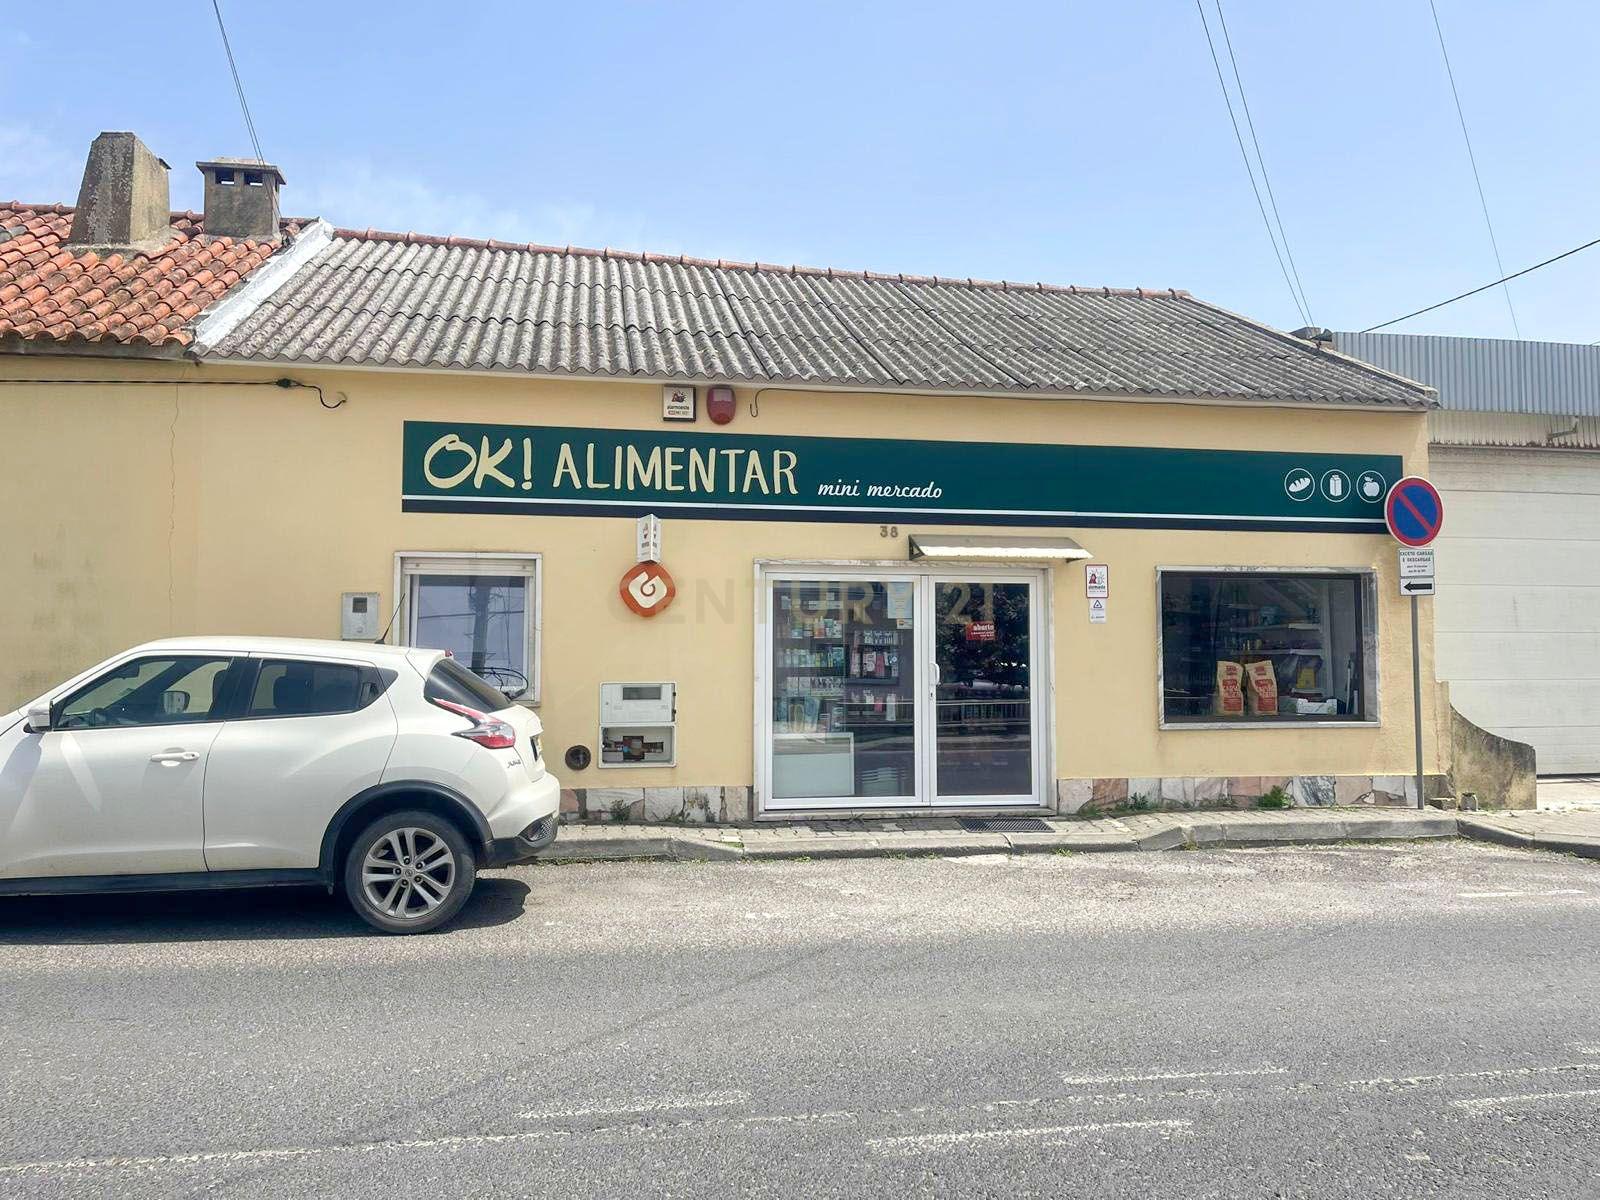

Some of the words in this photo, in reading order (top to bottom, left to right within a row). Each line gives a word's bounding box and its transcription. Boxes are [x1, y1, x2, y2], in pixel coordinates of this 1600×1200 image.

[423, 433, 533, 490] OK!
[552, 442, 799, 495] ALIMENTAR
[817, 478, 861, 497] mini
[867, 481, 943, 499] mercado
[879, 525, 899, 538] 38
